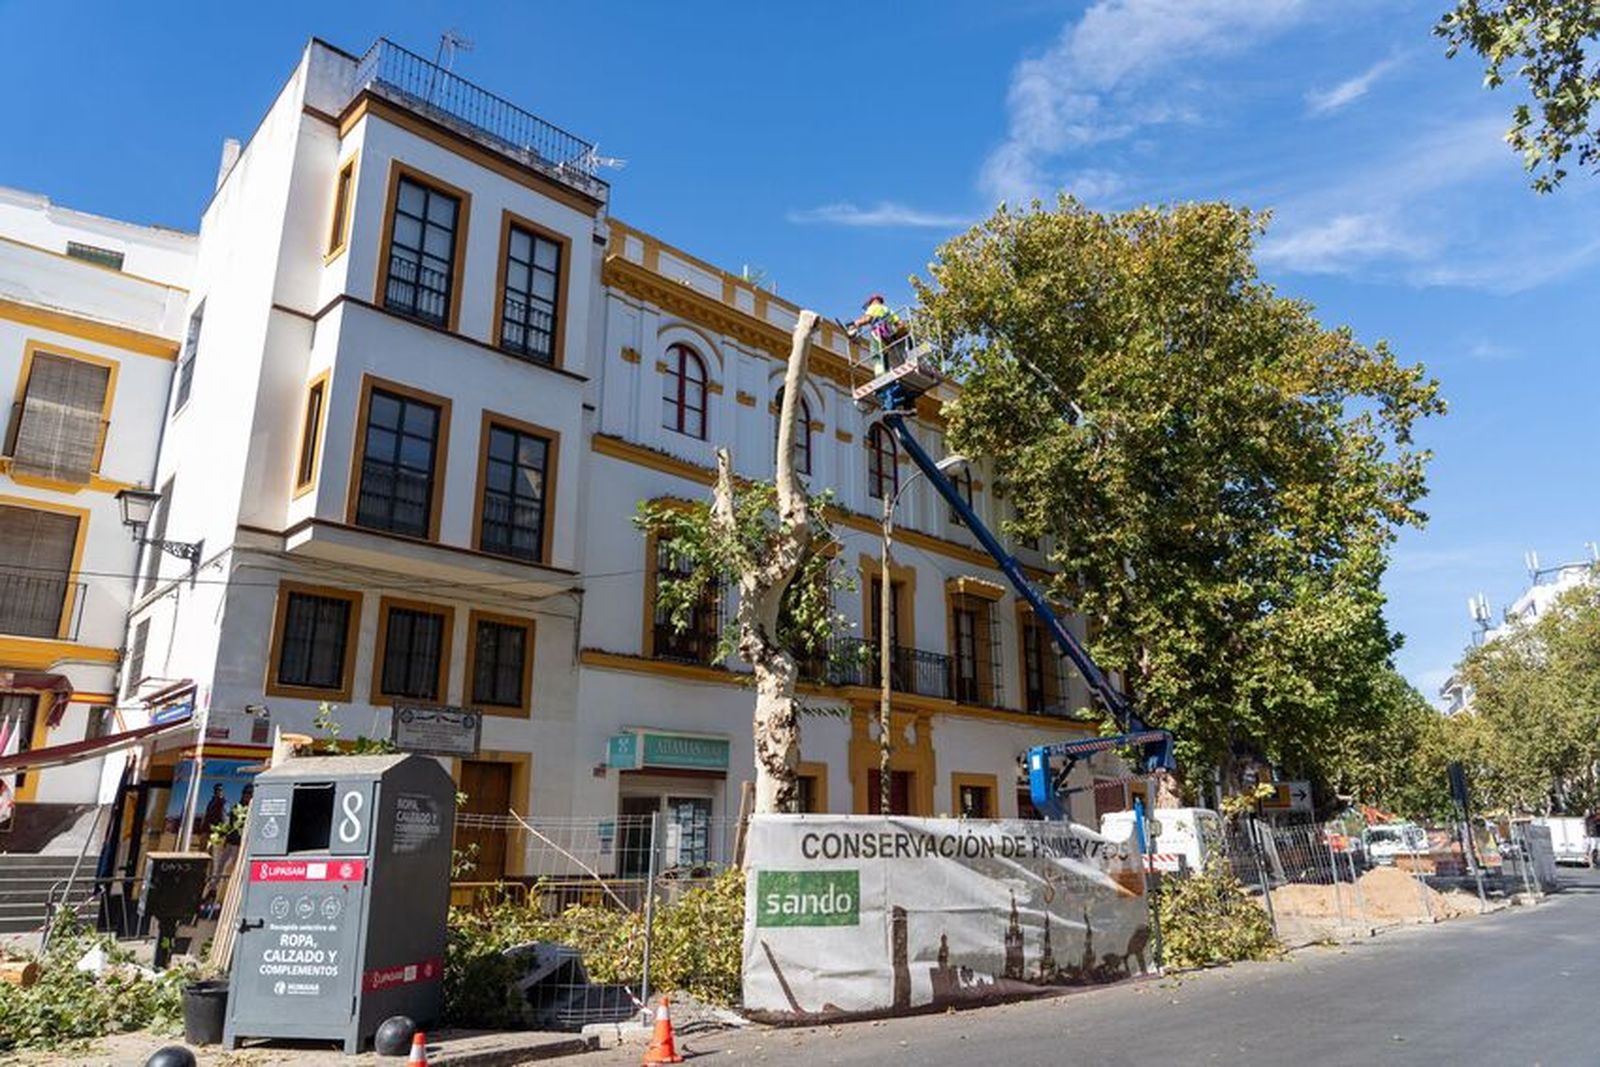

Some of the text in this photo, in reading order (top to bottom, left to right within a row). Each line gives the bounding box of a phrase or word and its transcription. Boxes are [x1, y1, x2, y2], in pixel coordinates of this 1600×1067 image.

[801, 830, 995, 859] CONSERVACIÓN
[1001, 836, 1027, 859] DE
[766, 882, 852, 914] sando
[280, 934, 317, 949] ROPA,
[263, 949, 338, 963] CALZADO Y
[259, 964, 339, 977] COMPLEMENTOS
